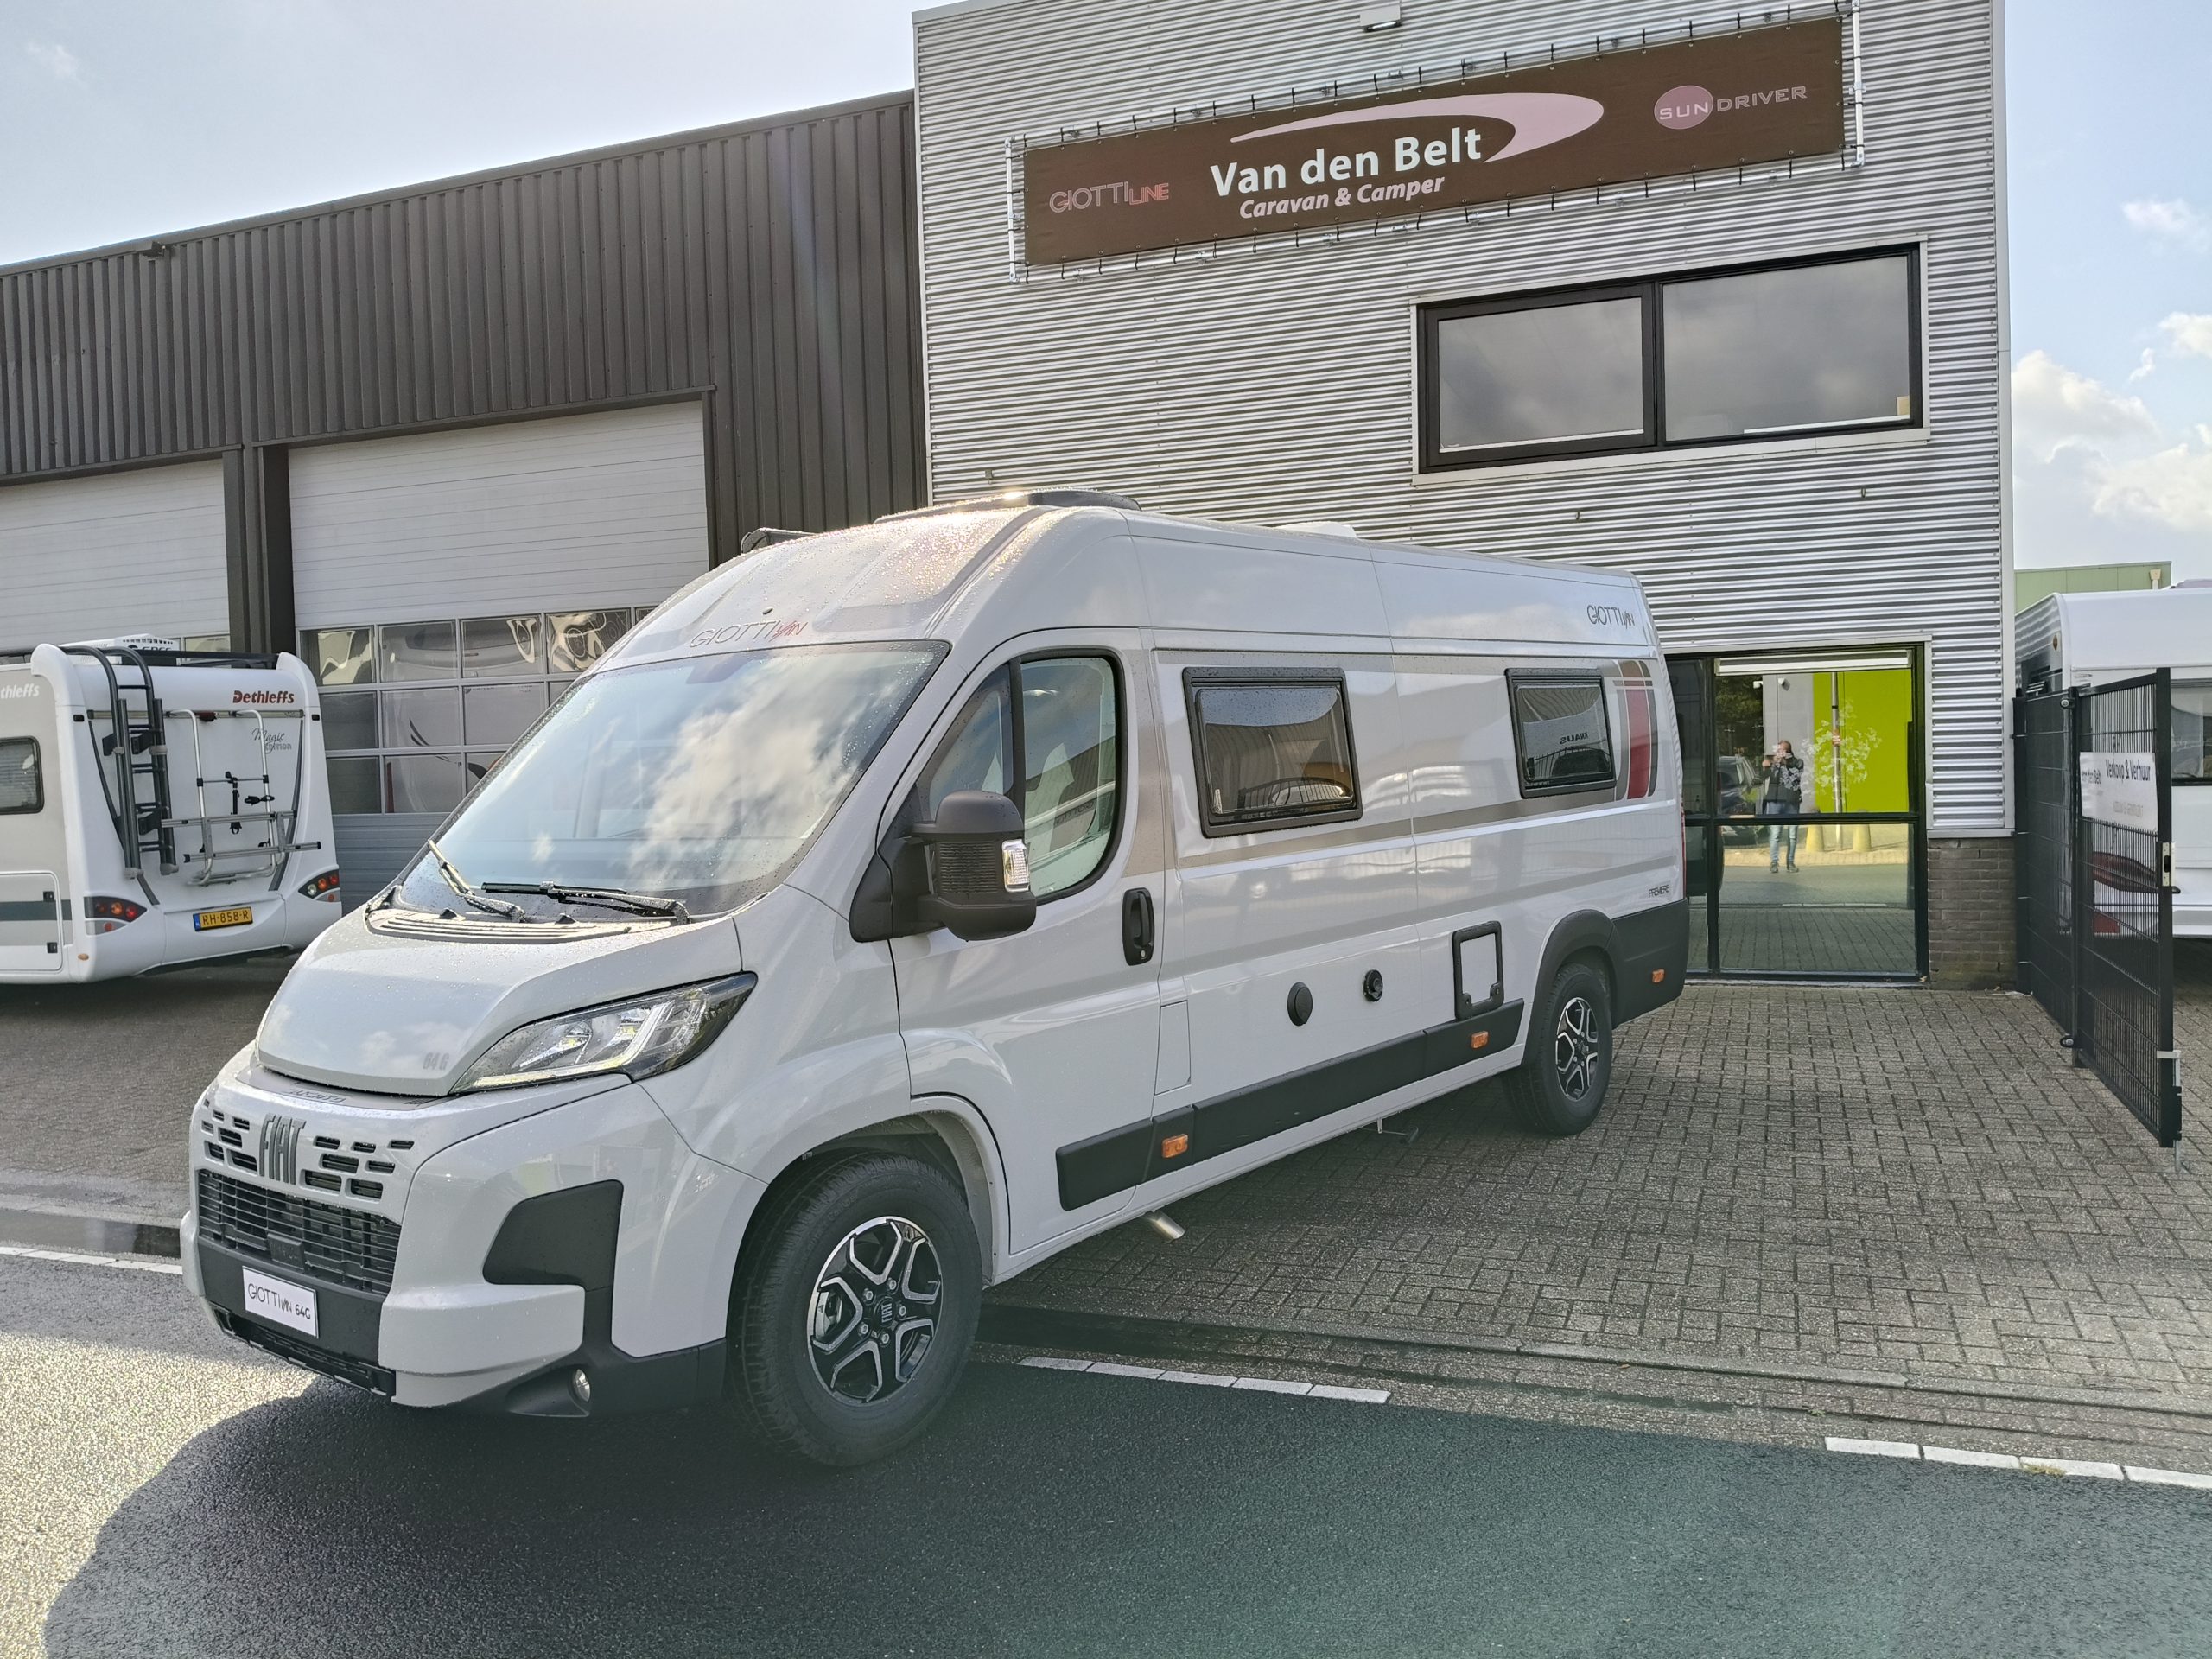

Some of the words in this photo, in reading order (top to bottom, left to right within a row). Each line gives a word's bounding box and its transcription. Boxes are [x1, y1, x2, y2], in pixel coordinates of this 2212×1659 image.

[1210, 162, 1287, 197] Van
[1300, 148, 1380, 184] den
[1395, 126, 1483, 172] Belt
[1239, 193, 1329, 219] Caravan
[1334, 188, 1352, 207] &
[1356, 176, 1446, 203] Camper
[232, 690, 295, 704] Dethleffs
[2105, 758, 2125, 784] Verkoop
[2125, 759, 2130, 779] &
[2130, 759, 2151, 781] Verhuur
[202, 909, 249, 925] RH-858-R
[259, 1112, 307, 1185] FIAT
[881, 1302, 893, 1323] FIAT
